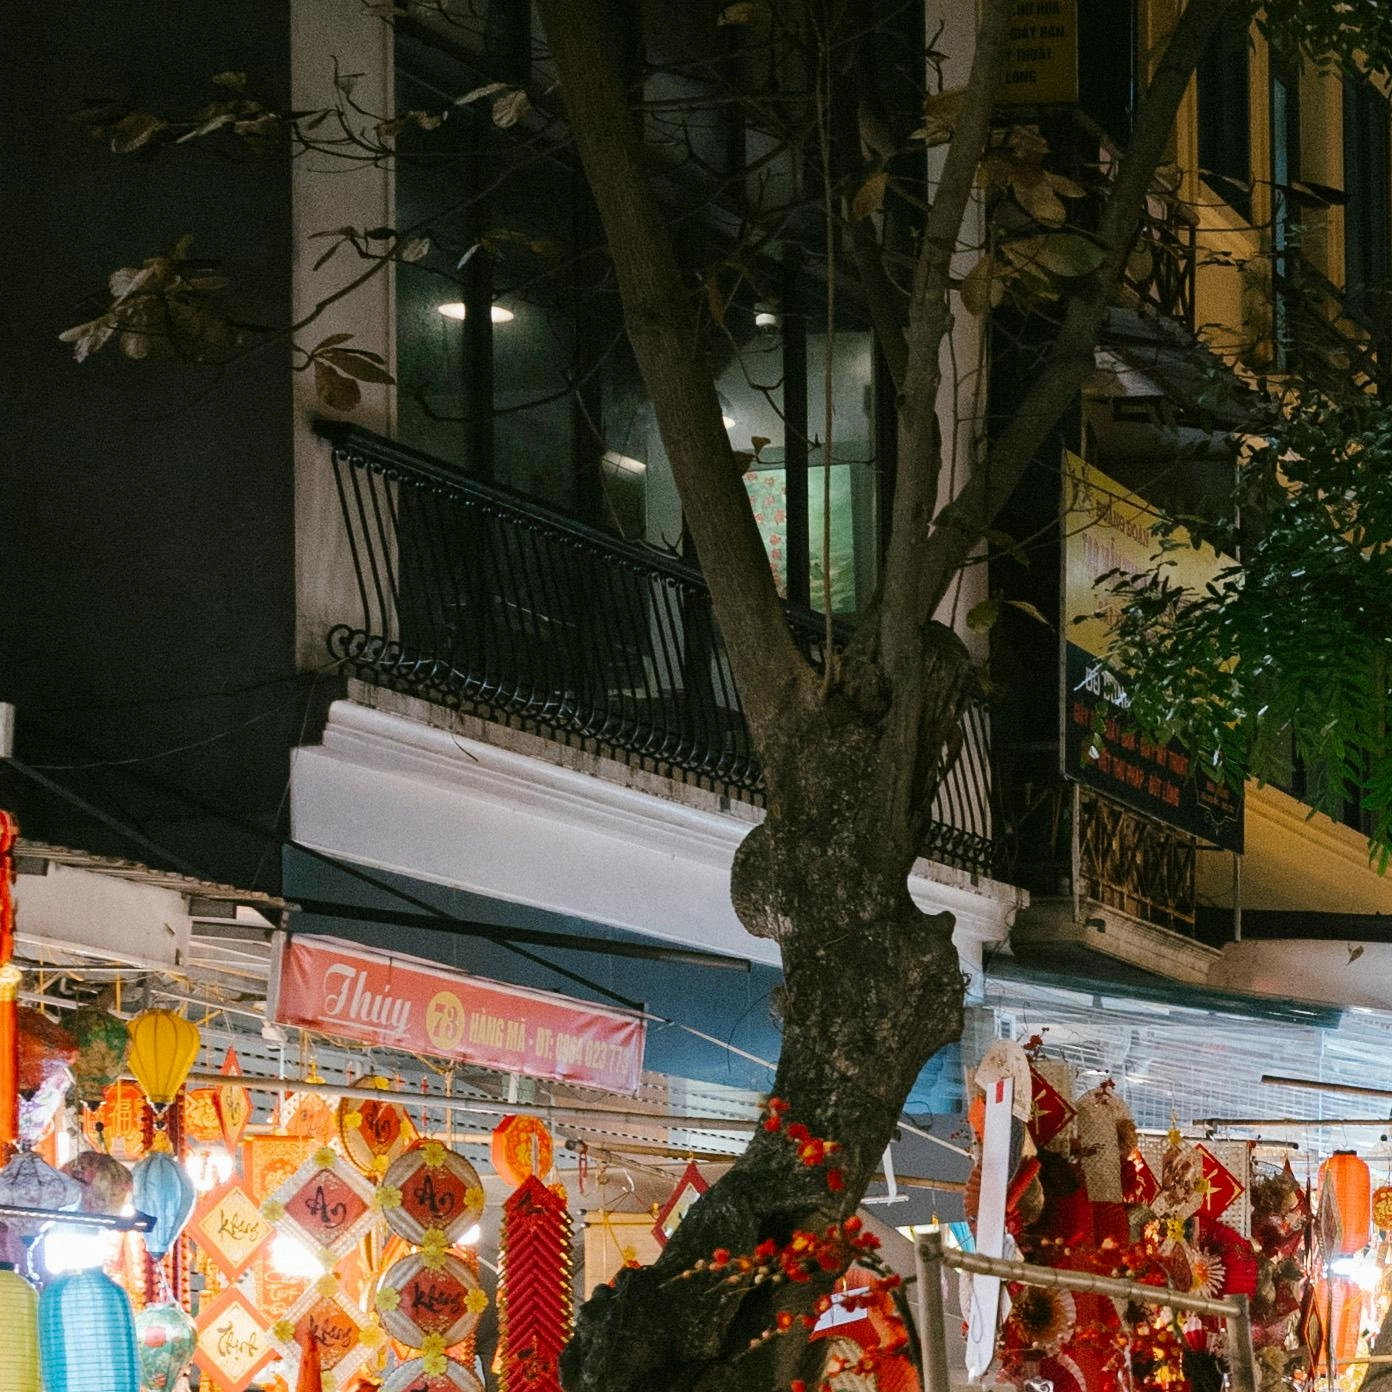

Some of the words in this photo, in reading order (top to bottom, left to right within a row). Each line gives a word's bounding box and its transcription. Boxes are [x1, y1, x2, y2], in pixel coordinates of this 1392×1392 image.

[323, 963, 412, 1038] Thúy
[434, 1003, 458, 1043] 73
[304, 1185, 347, 1229] An
[413, 1174, 453, 1218] An
